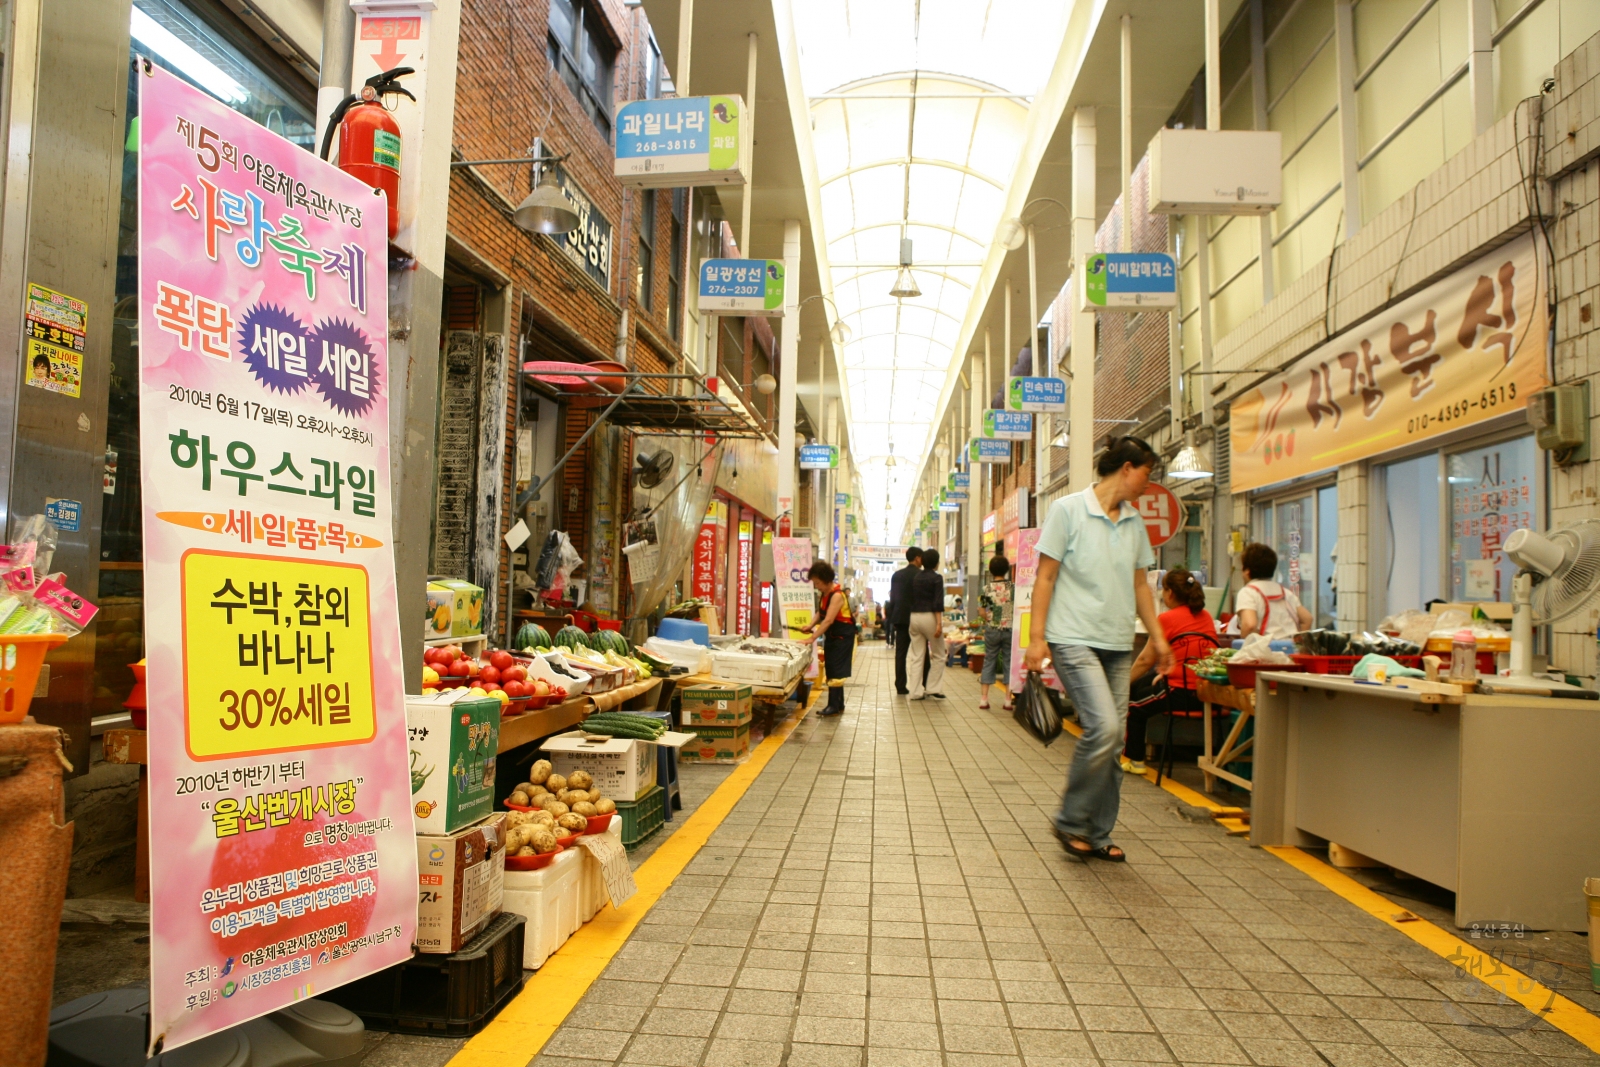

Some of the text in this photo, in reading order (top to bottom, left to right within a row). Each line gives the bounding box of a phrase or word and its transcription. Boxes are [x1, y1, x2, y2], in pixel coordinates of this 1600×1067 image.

[362, 19, 418, 38] 소화기
[622, 110, 705, 136] 과일나라
[713, 136, 735, 149] 과일
[635, 139, 697, 153] 268-3815
[175, 114, 364, 229] 제5회 야음체육관시장
[171, 175, 368, 315] 사랑축제
[705, 265, 761, 283] 일광생선
[708, 285, 759, 295] 276-2307
[1108, 261, 1173, 278] 이씨할매채소
[156, 284, 371, 400] 폭탄 세일 세일
[1305, 260, 1517, 430] 시장분식
[1024, 382, 1063, 394] 민속떡집
[1406, 383, 1518, 435] 010-4369-6513
[168, 384, 374, 447] 2010년 6월 17일(목) 오후2시~오후5시
[168, 427, 377, 518] 하우스과일
[223, 508, 347, 555] 세일품목
[210, 577, 350, 629] 수박,참외
[238, 629, 335, 675] 바나나
[218, 681, 352, 732] 30%세일
[710, 691, 734, 699] BANANAS
[176, 761, 306, 794] 2010년 하반기 부터
[304, 831, 323, 847] 으로
[200, 851, 378, 915] 온누리 상품권 및 희망근로 상품권
[210, 878, 377, 938] 이용고객을 특별히 환영합니다.
[240, 922, 349, 967] 야음체육관시장상인회
[416, 938, 441, 946] 정농협
[239, 954, 312, 991] 시장경영진흥원
